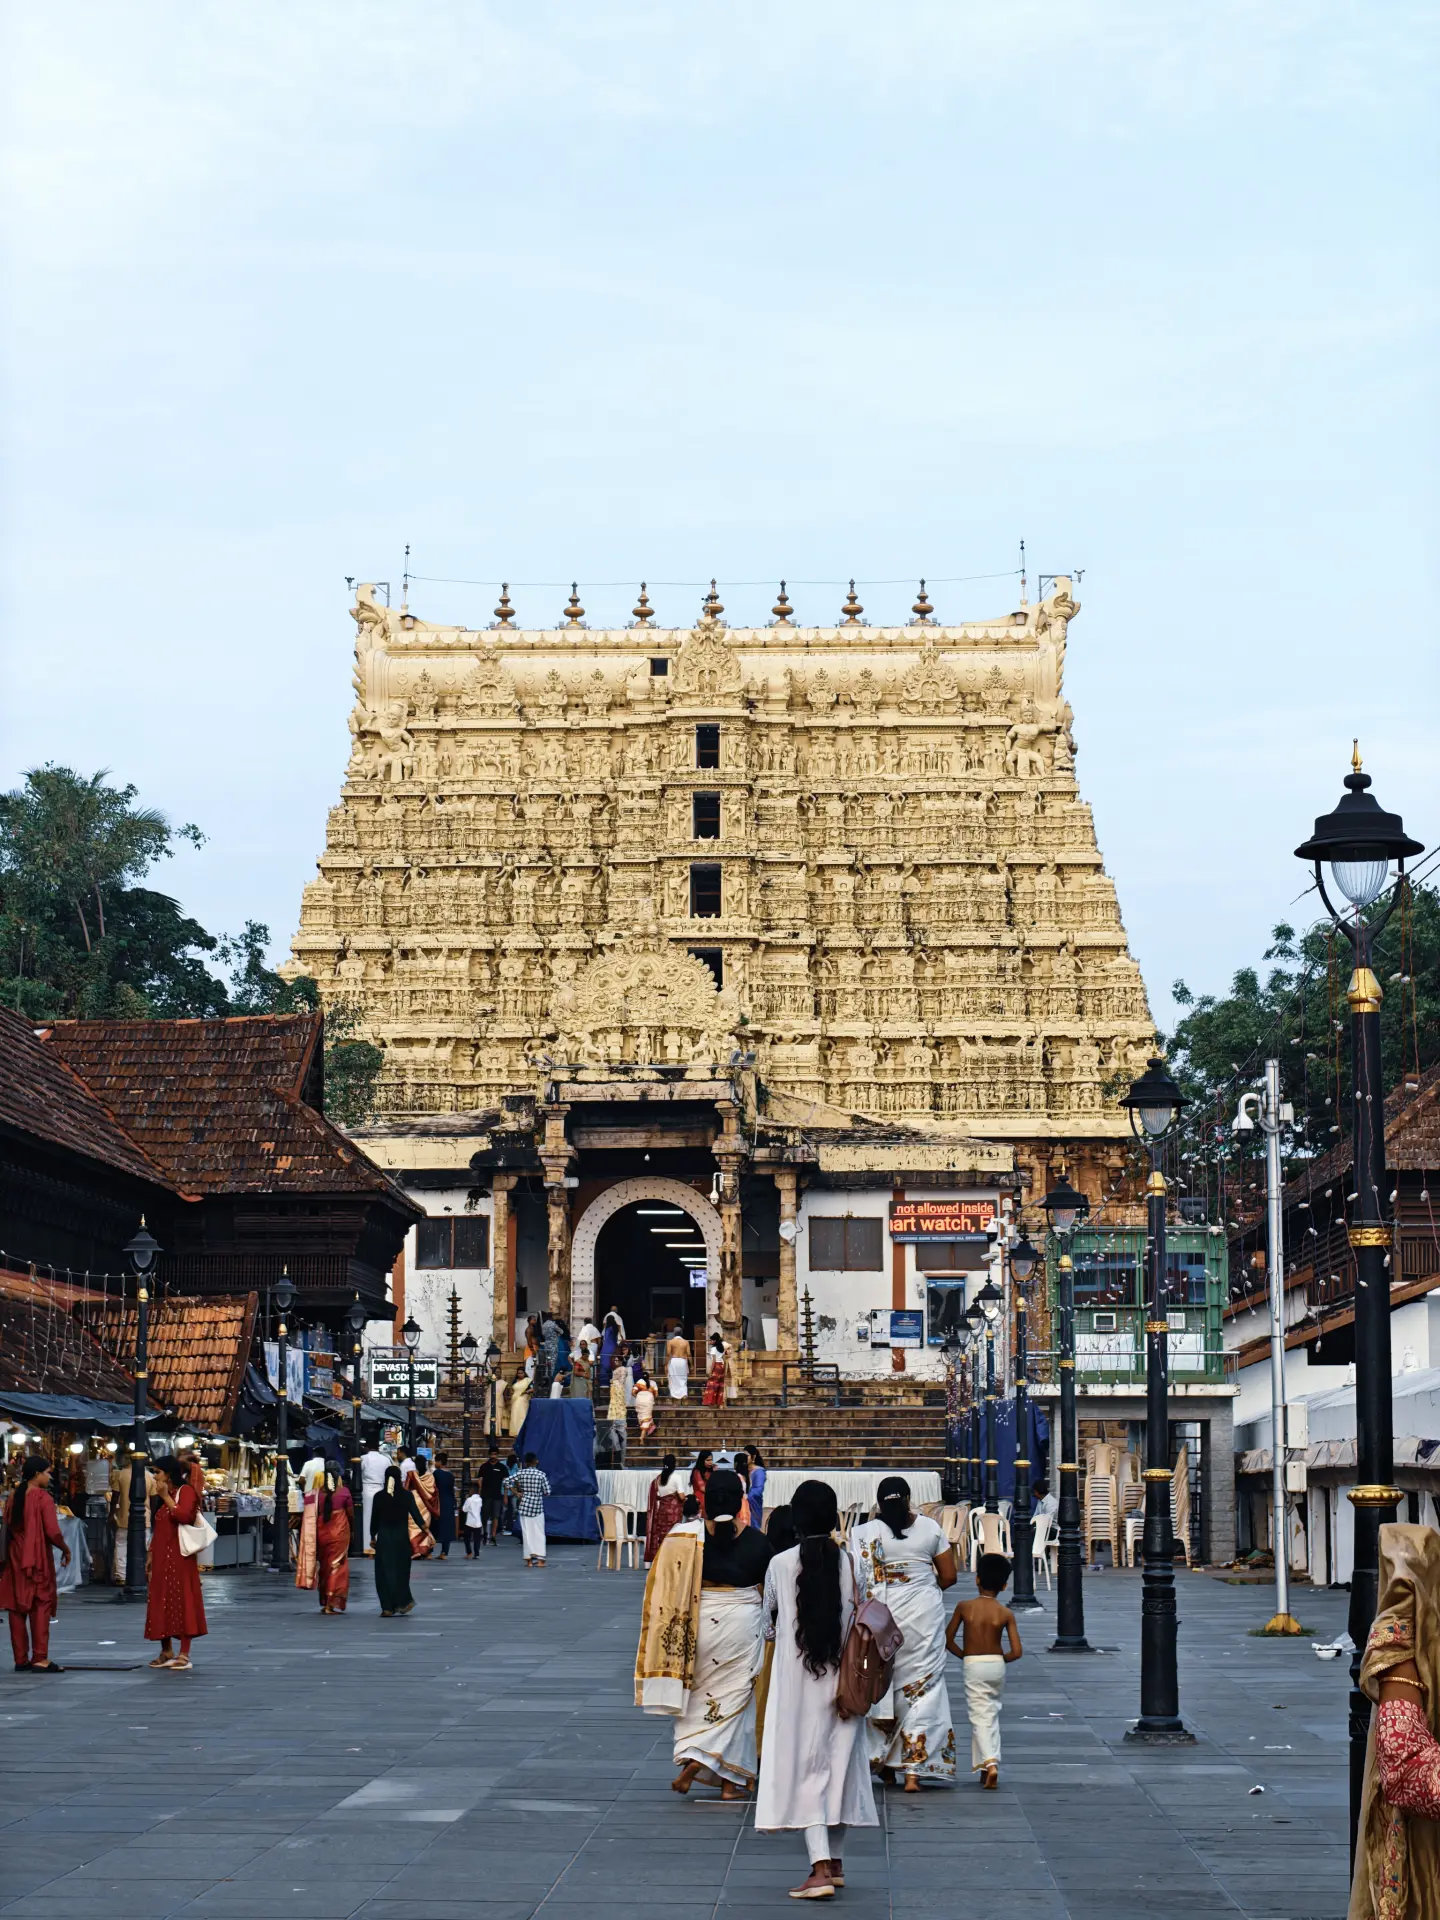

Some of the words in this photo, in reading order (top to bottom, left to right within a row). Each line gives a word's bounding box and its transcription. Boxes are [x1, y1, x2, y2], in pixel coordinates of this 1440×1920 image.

[896, 1203, 915, 1214] not
[917, 1202, 959, 1214] allowed
[961, 1202, 994, 1213] inside
[920, 1214, 976, 1233] watch,
[388, 1373, 420, 1381] LODE
